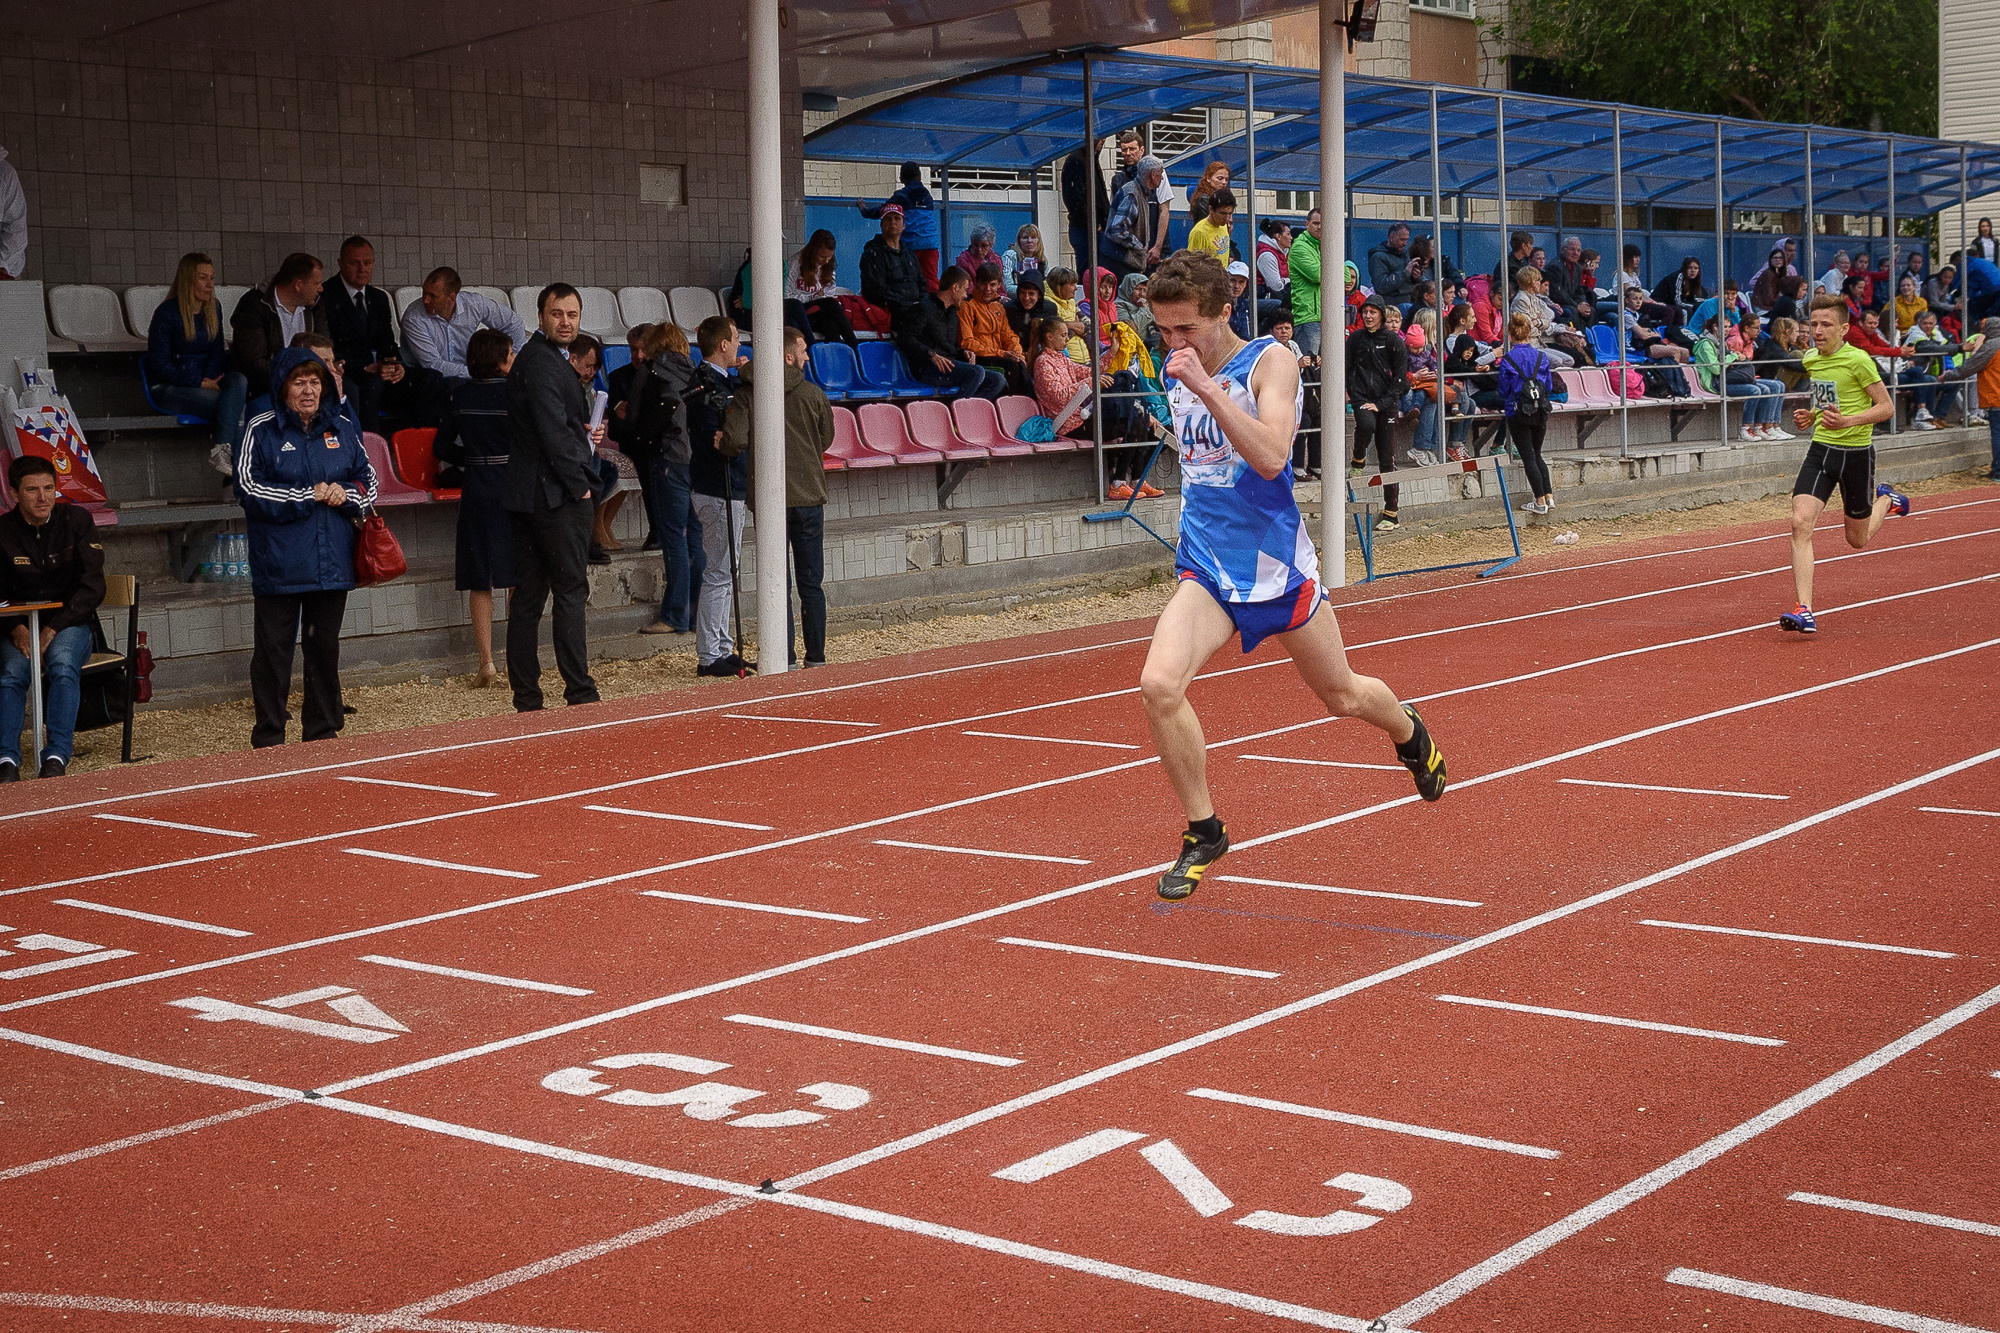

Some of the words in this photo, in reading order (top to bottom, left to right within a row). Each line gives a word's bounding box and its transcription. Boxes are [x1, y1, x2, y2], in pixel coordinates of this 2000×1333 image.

[1182, 414, 1223, 450] 440
[164, 985, 413, 1044] 4
[540, 1052, 872, 1128] 3
[992, 1128, 1413, 1238] 2
